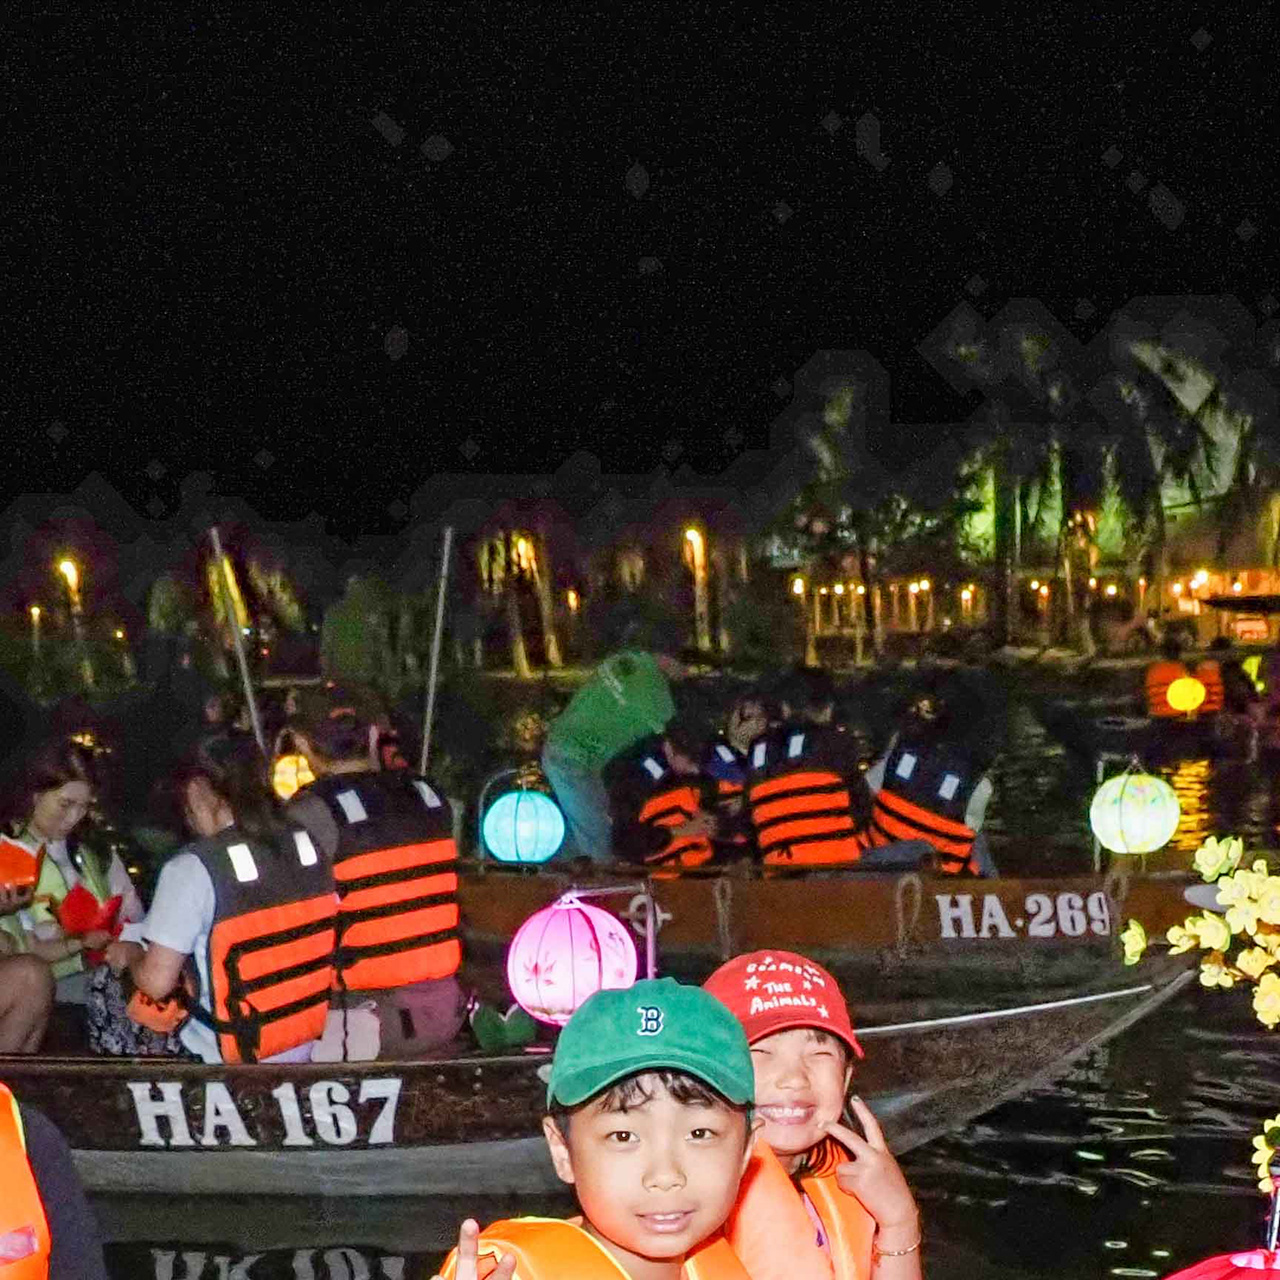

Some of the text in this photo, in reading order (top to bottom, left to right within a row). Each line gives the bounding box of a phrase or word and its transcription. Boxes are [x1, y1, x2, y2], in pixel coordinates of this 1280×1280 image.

[636, 1005, 664, 1036] B
[127, 1078, 402, 1146] HA 167
